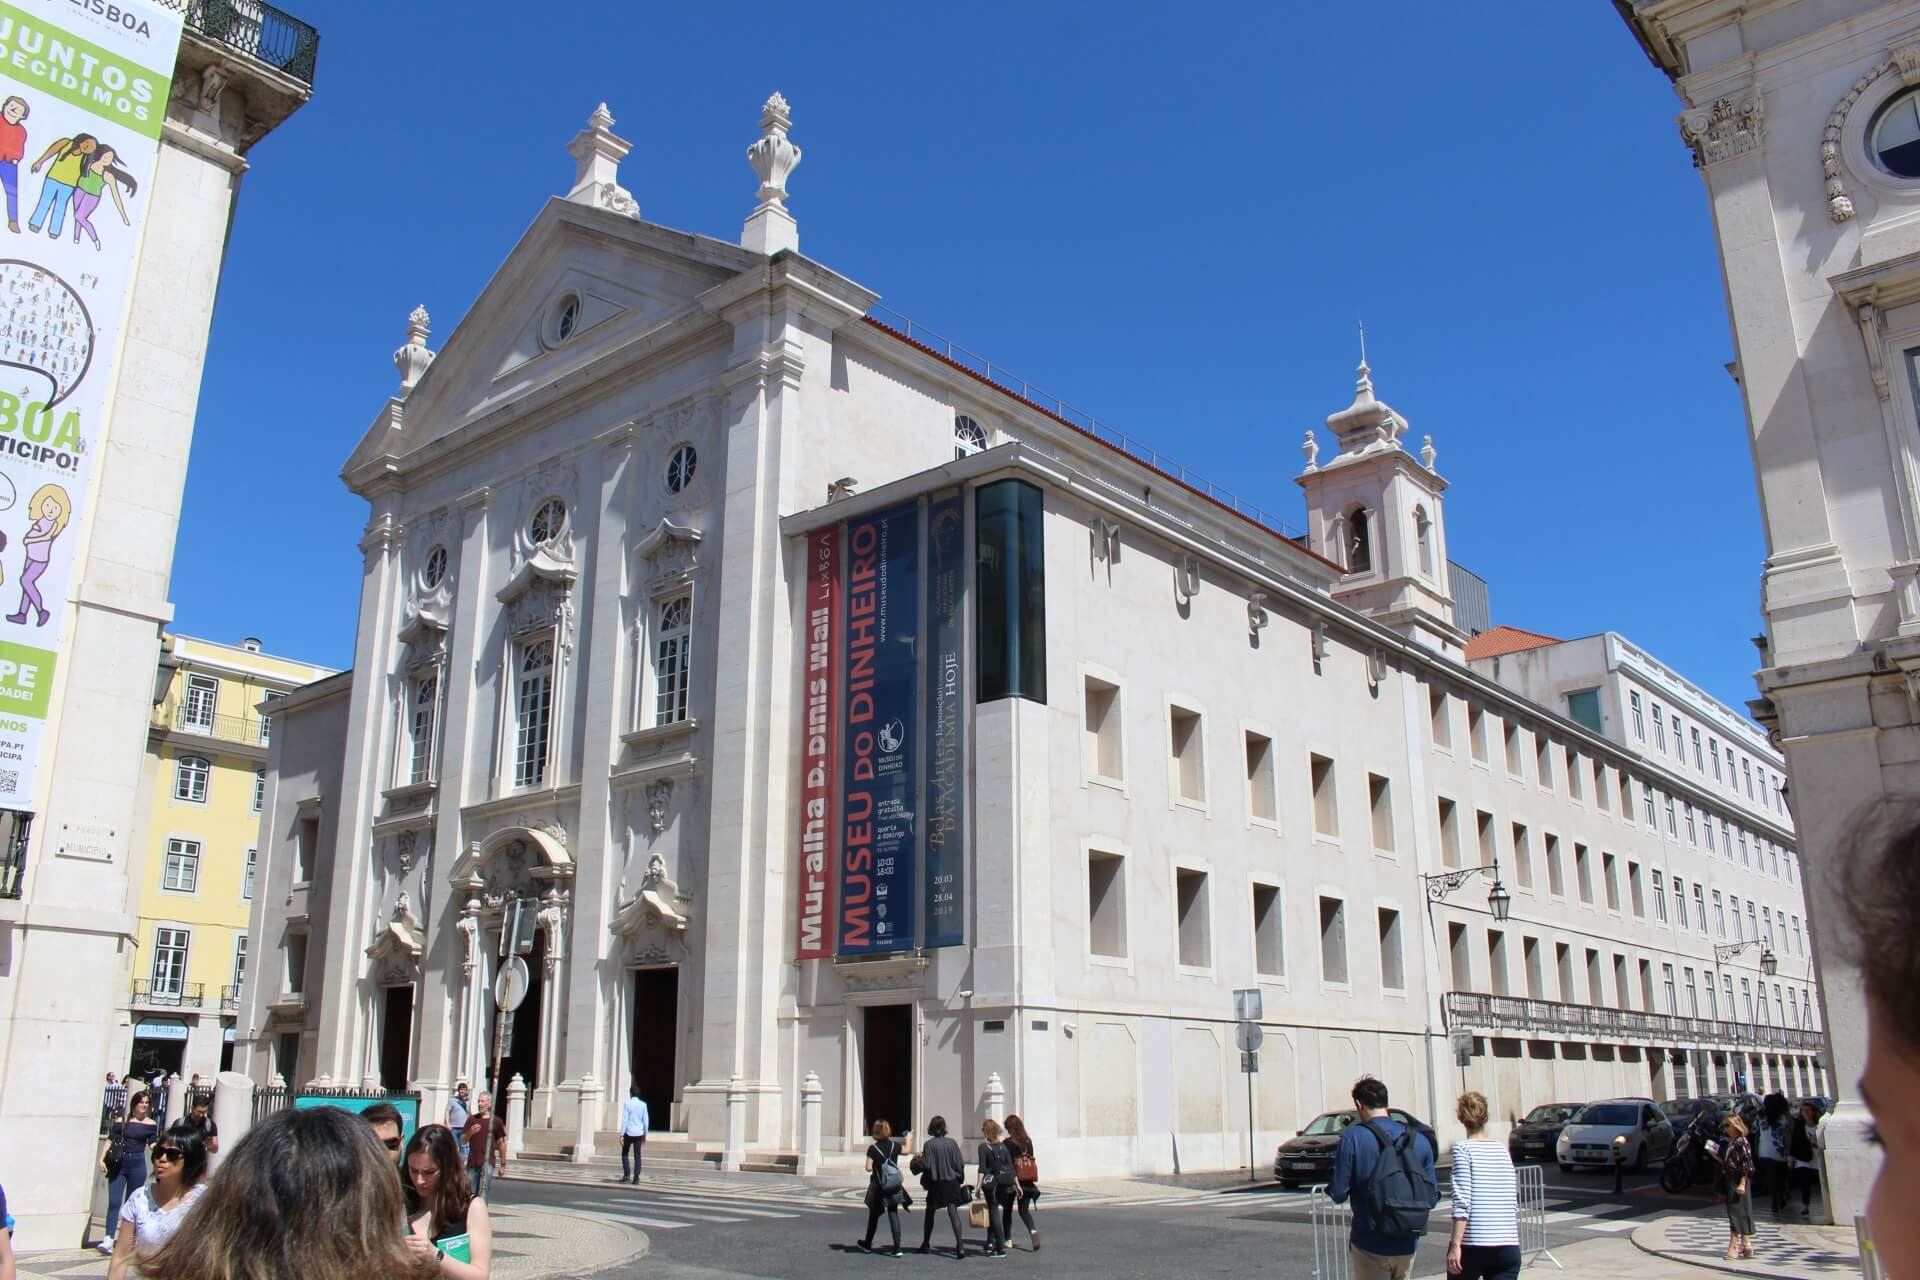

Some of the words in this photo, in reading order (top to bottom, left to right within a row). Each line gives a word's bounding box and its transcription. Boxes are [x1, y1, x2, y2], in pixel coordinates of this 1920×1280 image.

[69, 0, 151, 38] ISBOA
[0, 17, 153, 103] JUNTOS
[879, 518, 888, 643] www.museudodinheiro.pt
[810, 607, 829, 671] Wall
[850, 523, 878, 724] DINHEIRO
[945, 652, 958, 696] HOJE
[807, 760, 825, 789] D.
[855, 731, 874, 780] DO
[930, 738, 945, 793] Artes
[942, 702, 956, 803] ACADEMIA
[929, 797, 945, 851] Belas
[801, 797, 825, 950] Muralha
[844, 792, 872, 946] MUSEU
[877, 857, 894, 867] 10:00
